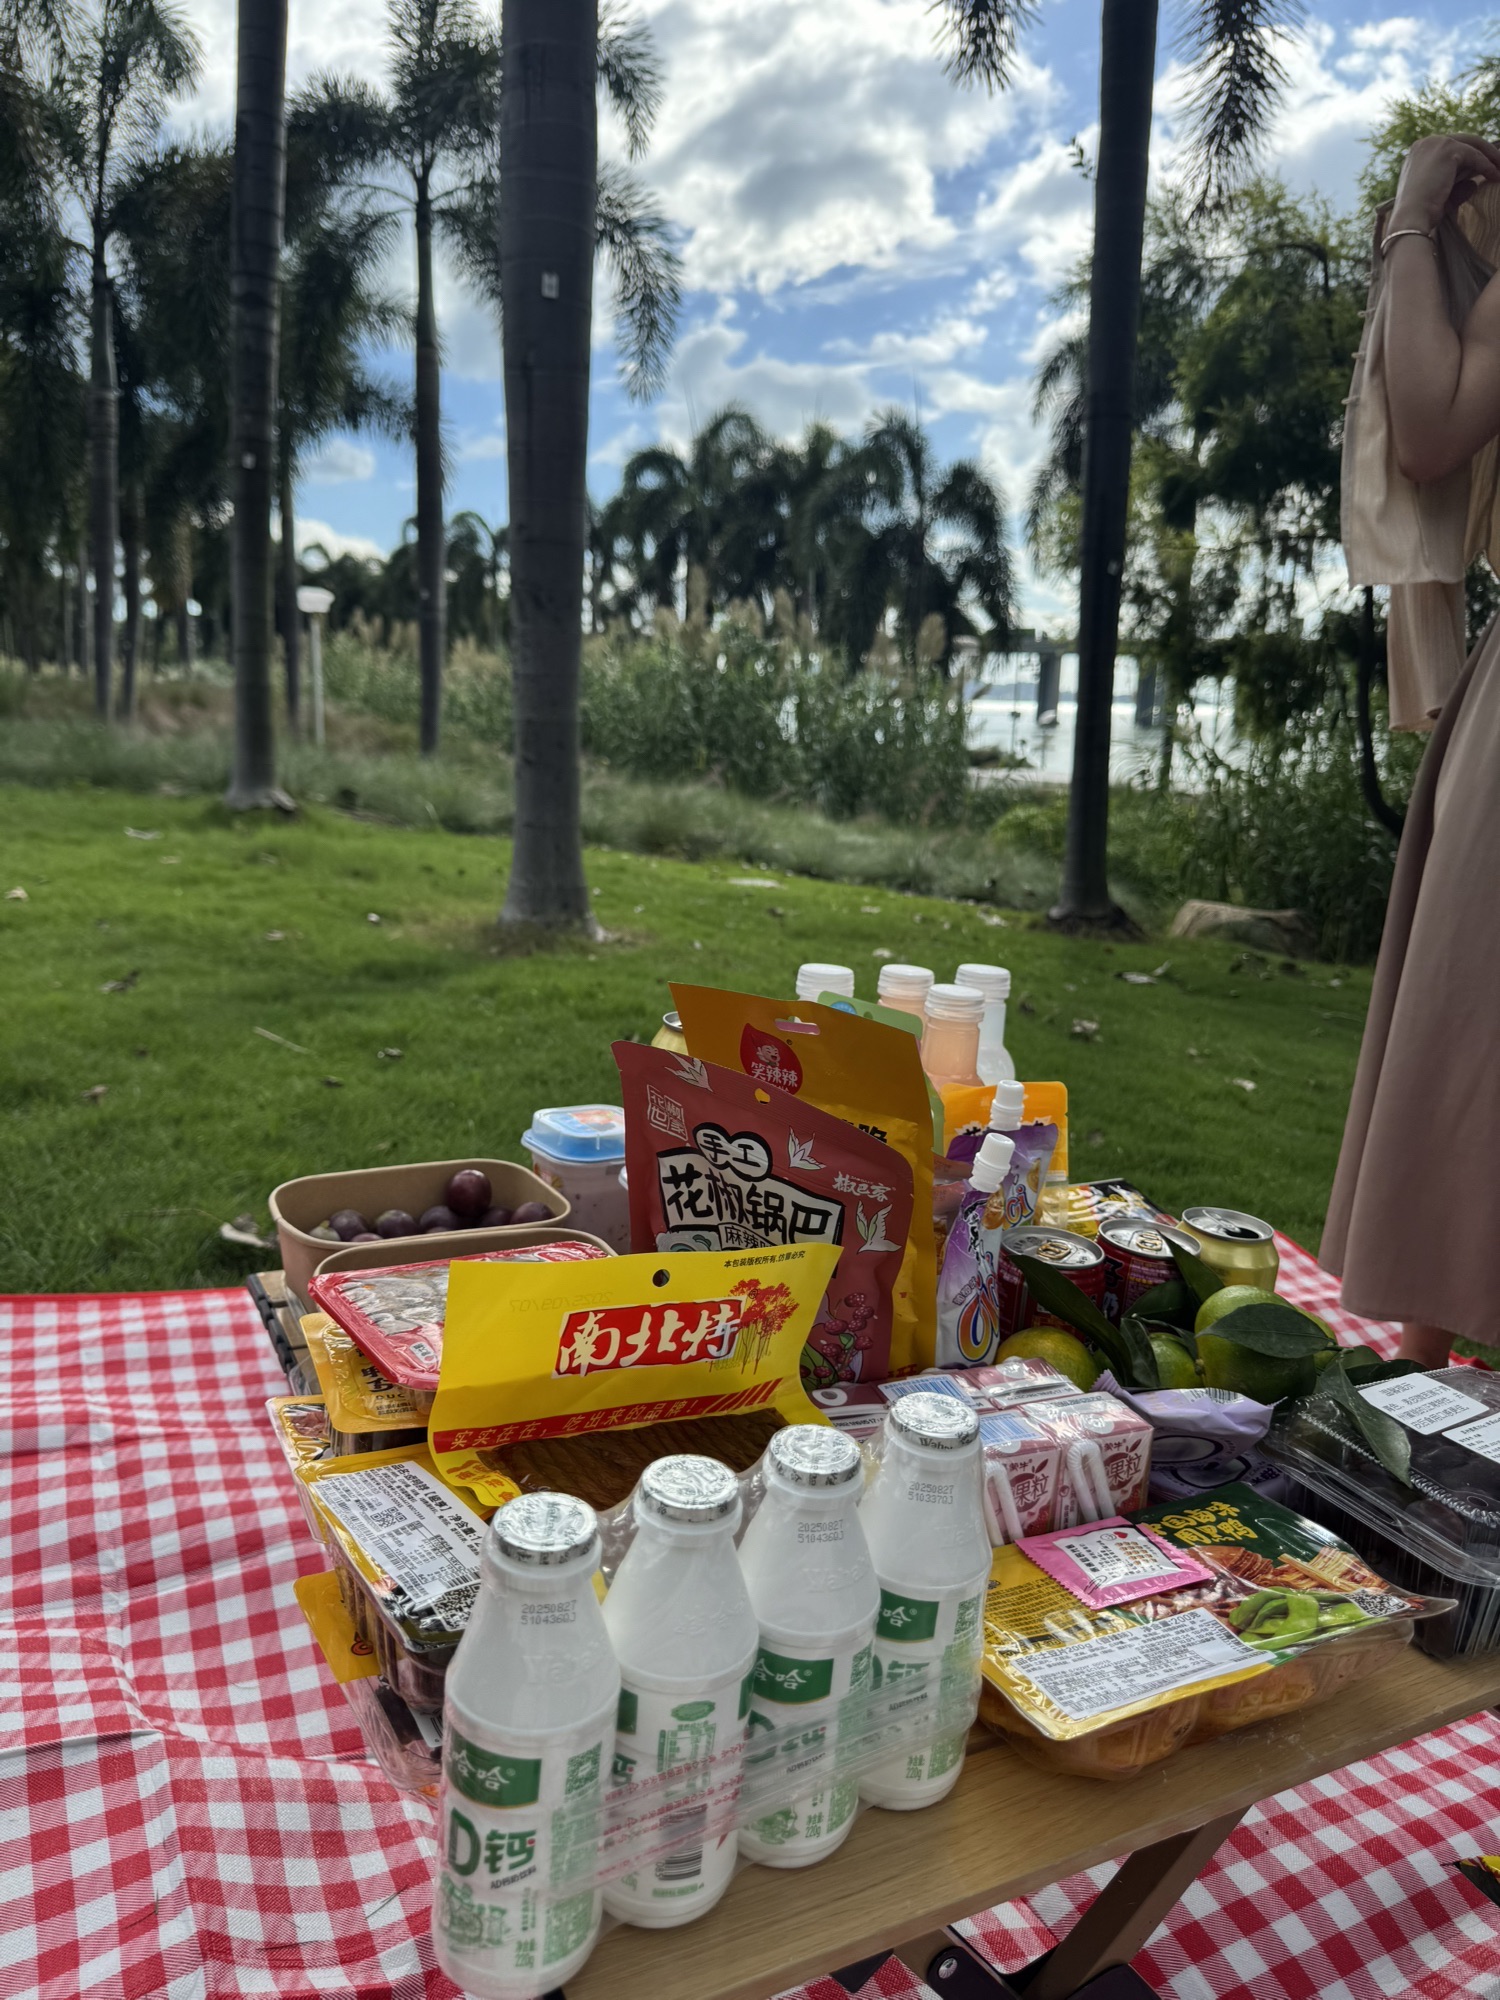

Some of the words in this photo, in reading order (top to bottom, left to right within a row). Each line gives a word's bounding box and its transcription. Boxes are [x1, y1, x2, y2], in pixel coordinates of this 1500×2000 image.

[751, 1062, 798, 1088] 笑辣辣
[700, 1133, 760, 1167] 手工
[662, 1162, 833, 1245] 花椒锅巴
[560, 1304, 741, 1377] 南北特
[1107, 1452, 1143, 1485] 果粒
[909, 1481, 954, 1495] 20250827
[1013, 1473, 1049, 1506] 果粒
[798, 1520, 844, 1533] 20250827
[1174, 1519, 1258, 1546] 周黑鸭
[521, 1600, 577, 1614] 20250827
[906, 1767, 922, 1780] 220g
[805, 1826, 821, 1838] 220g
[515, 1951, 535, 1968] 220g
